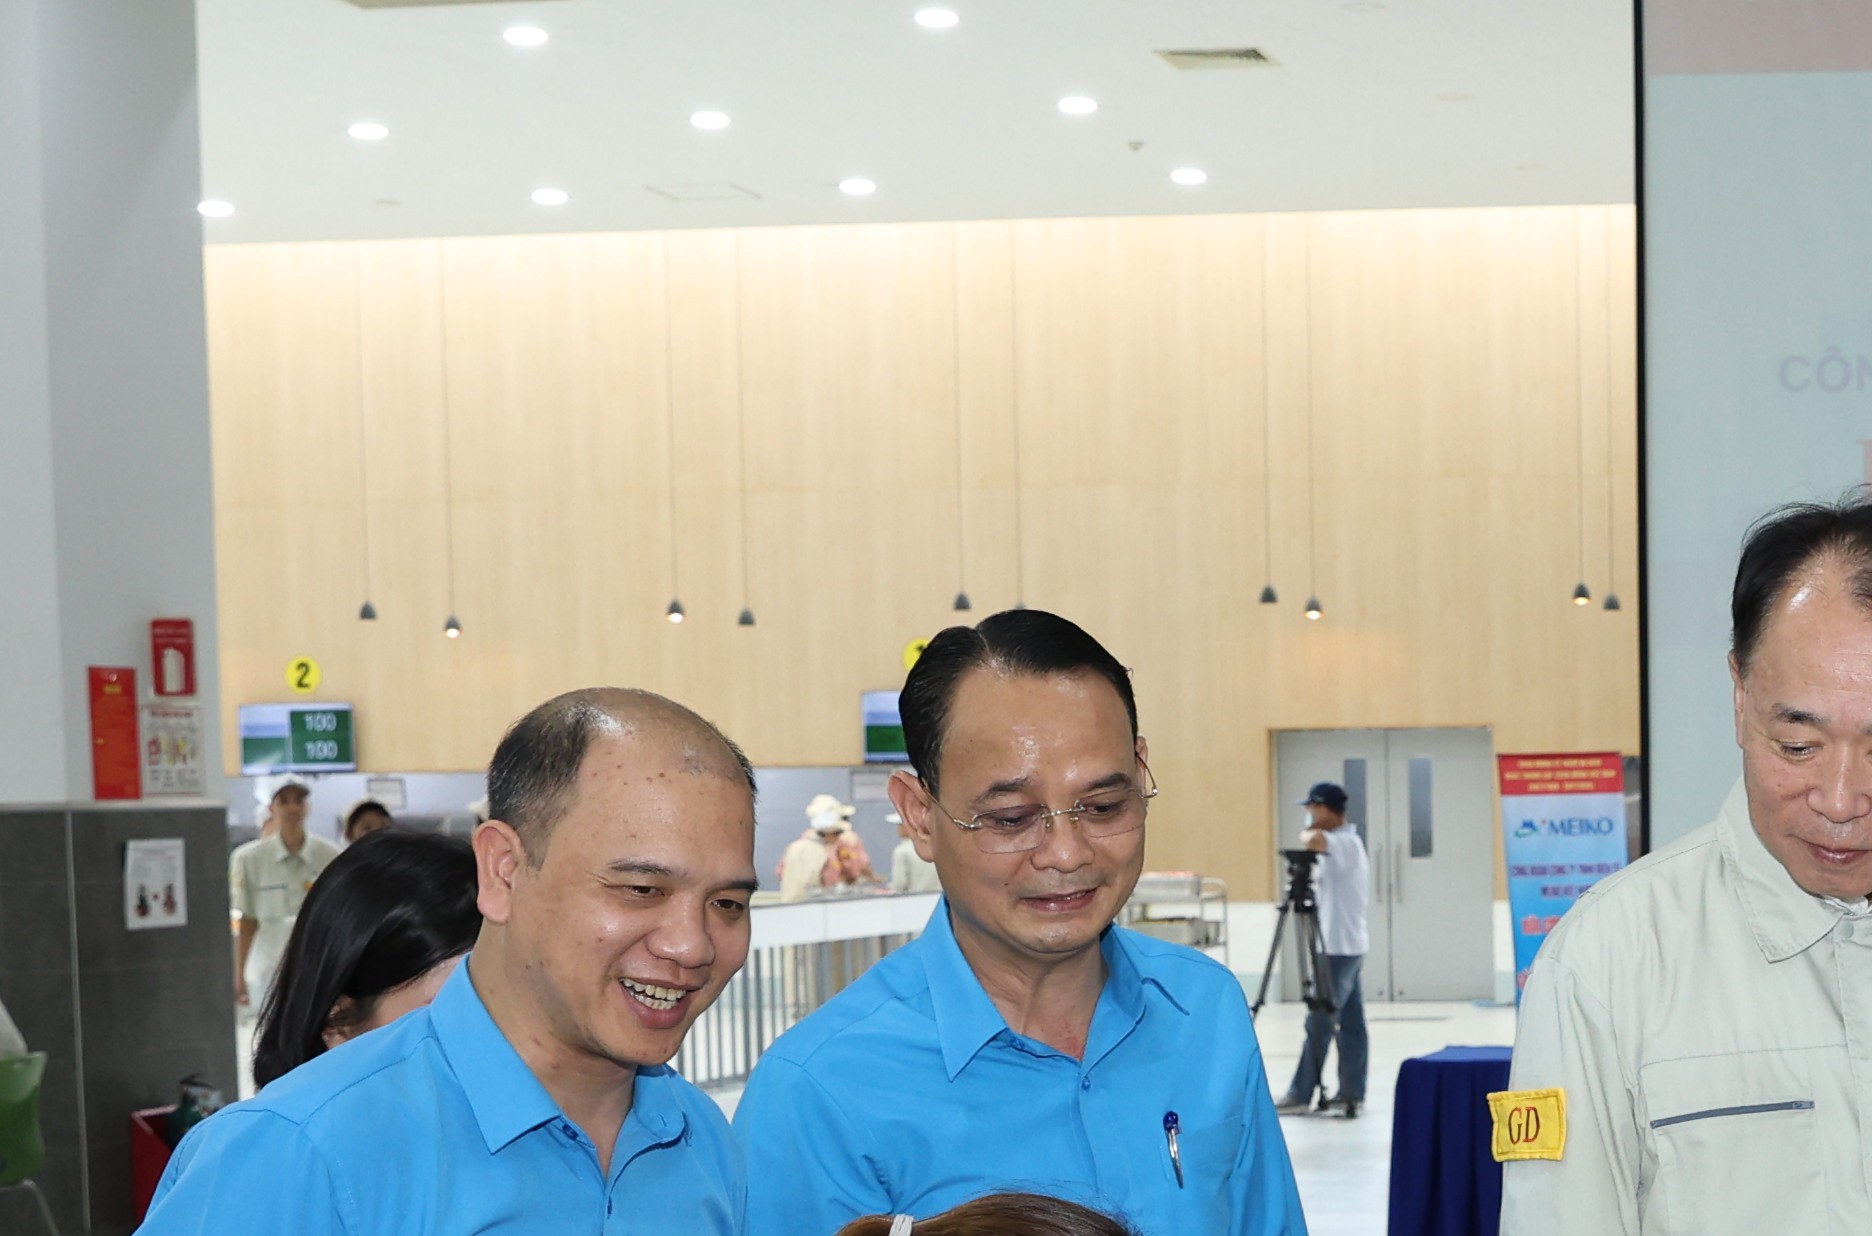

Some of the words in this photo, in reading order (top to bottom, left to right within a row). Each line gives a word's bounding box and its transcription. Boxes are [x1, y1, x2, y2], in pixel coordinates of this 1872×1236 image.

[295, 661, 312, 689] 2
[1548, 817, 1614, 836] MEIKO
[1507, 1106, 1540, 1145] GD
